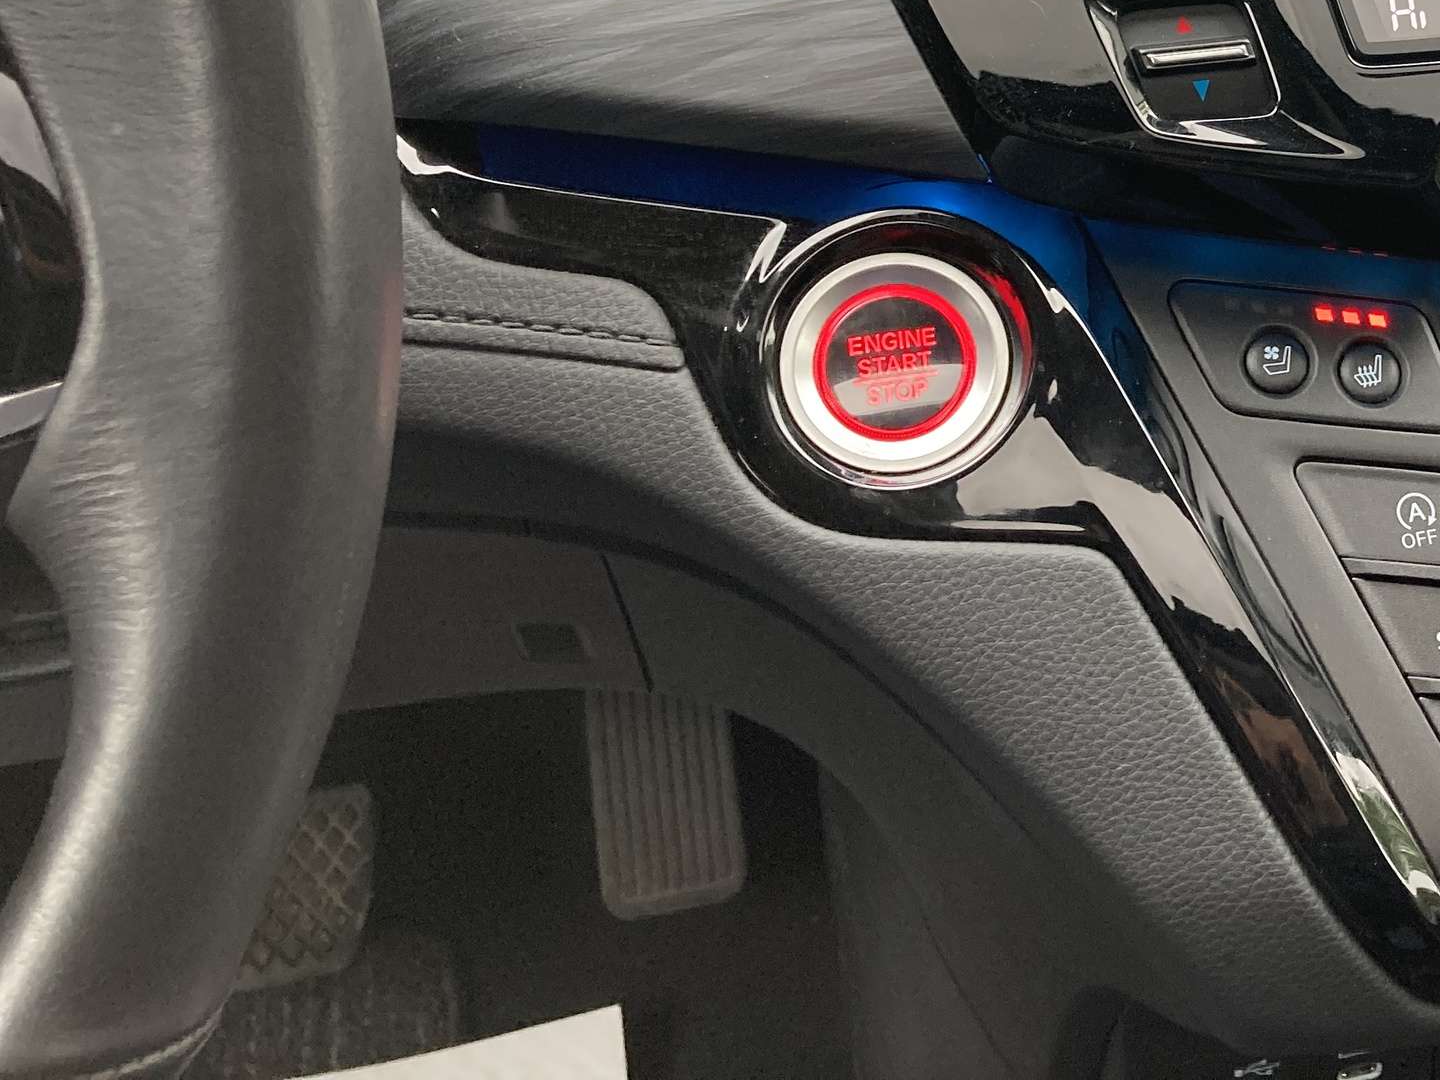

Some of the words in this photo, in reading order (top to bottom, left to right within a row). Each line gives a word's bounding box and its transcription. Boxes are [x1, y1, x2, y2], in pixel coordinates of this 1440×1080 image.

[847, 326, 937, 356] ENGINE
[857, 350, 931, 377] START
[866, 377, 929, 405] STOP
[1401, 529, 1438, 549] OFF
